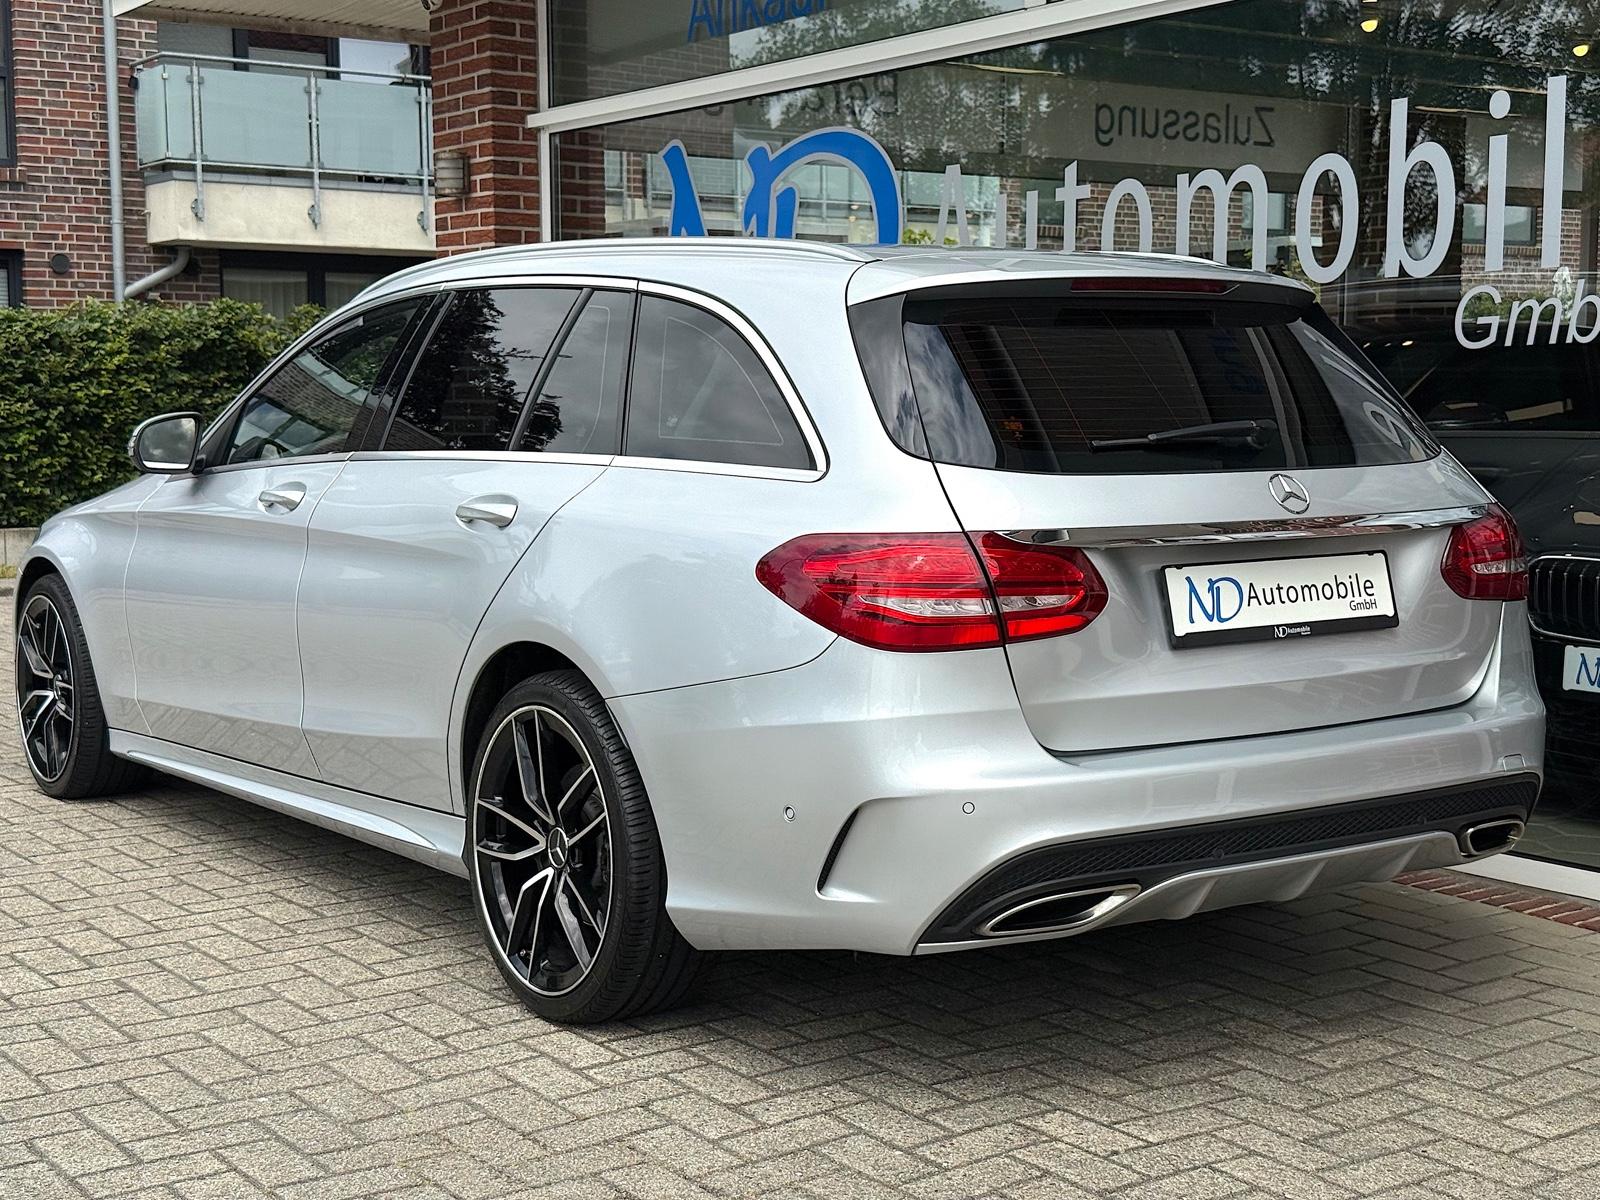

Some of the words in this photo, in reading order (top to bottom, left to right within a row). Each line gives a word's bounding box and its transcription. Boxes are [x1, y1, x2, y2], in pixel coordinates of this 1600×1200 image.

[1184, 576, 1244, 624] ND
[1247, 572, 1376, 607] Automobile
[1349, 599, 1378, 612] GmbH
